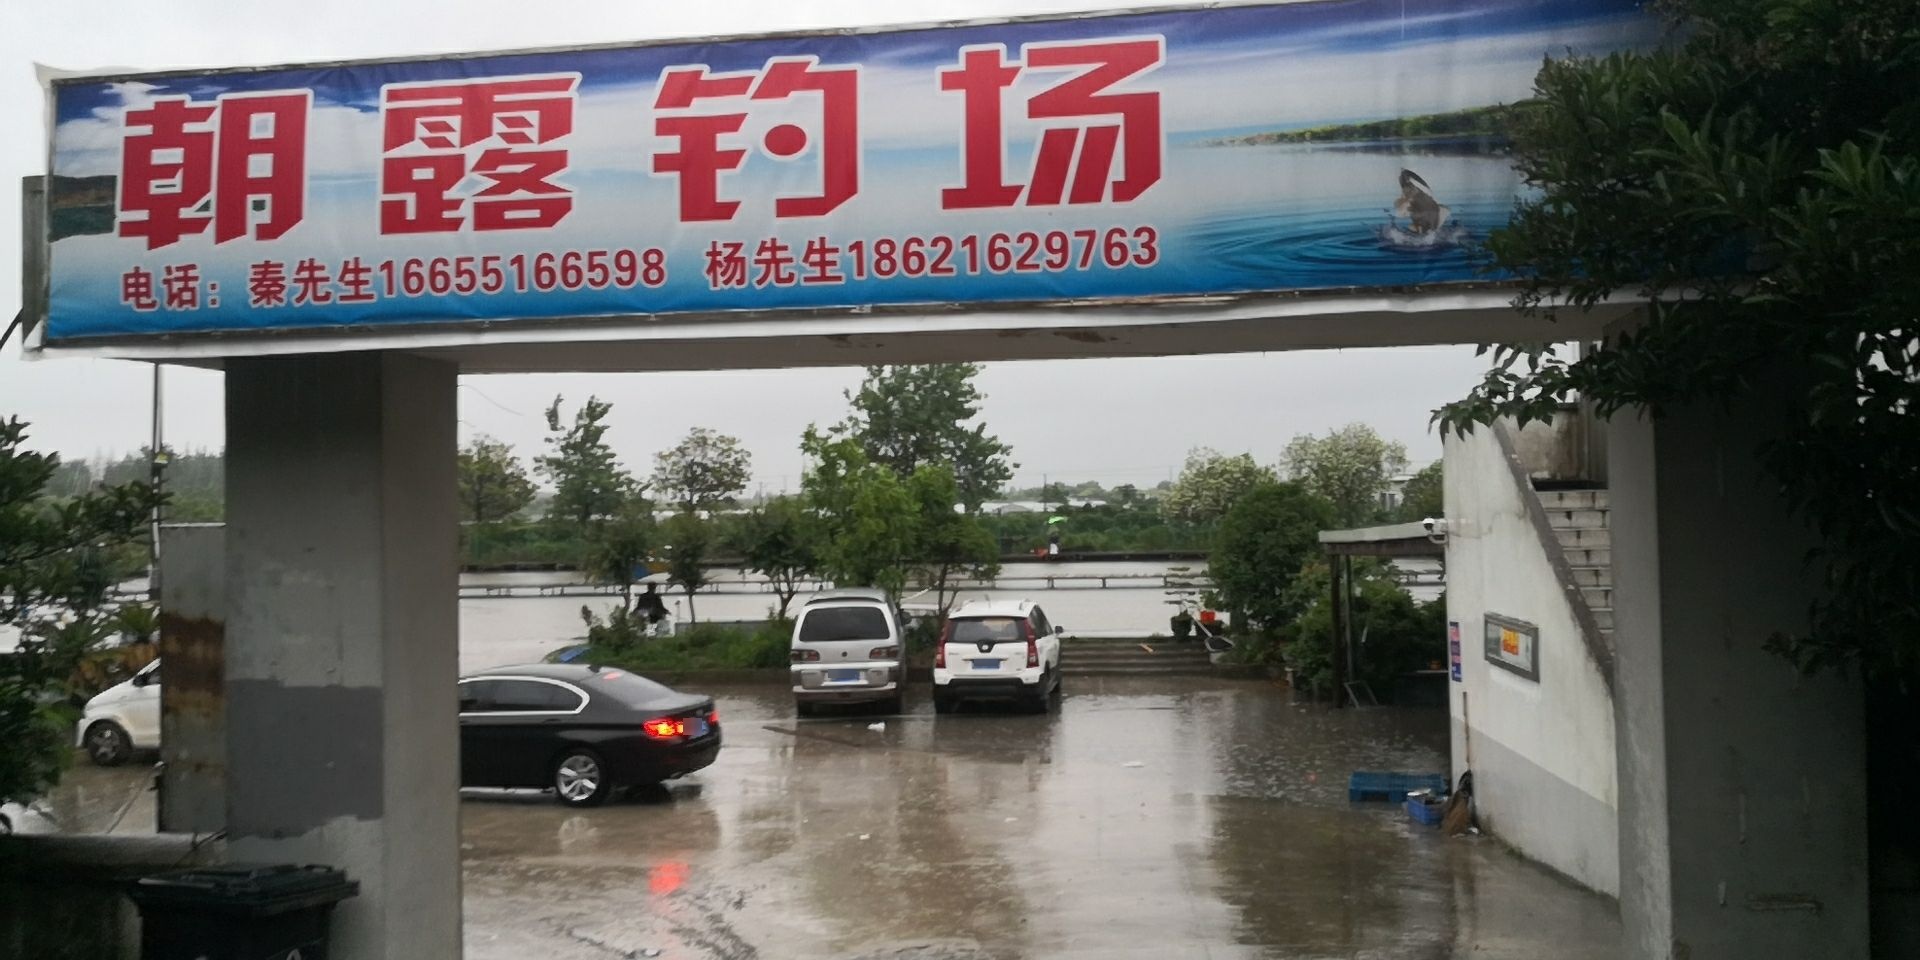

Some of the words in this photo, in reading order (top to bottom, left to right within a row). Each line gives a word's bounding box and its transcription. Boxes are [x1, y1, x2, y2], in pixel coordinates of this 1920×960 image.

[118, 40, 1163, 250] 朝露钓场
[705, 226, 1158, 287] 杨先生18621629763
